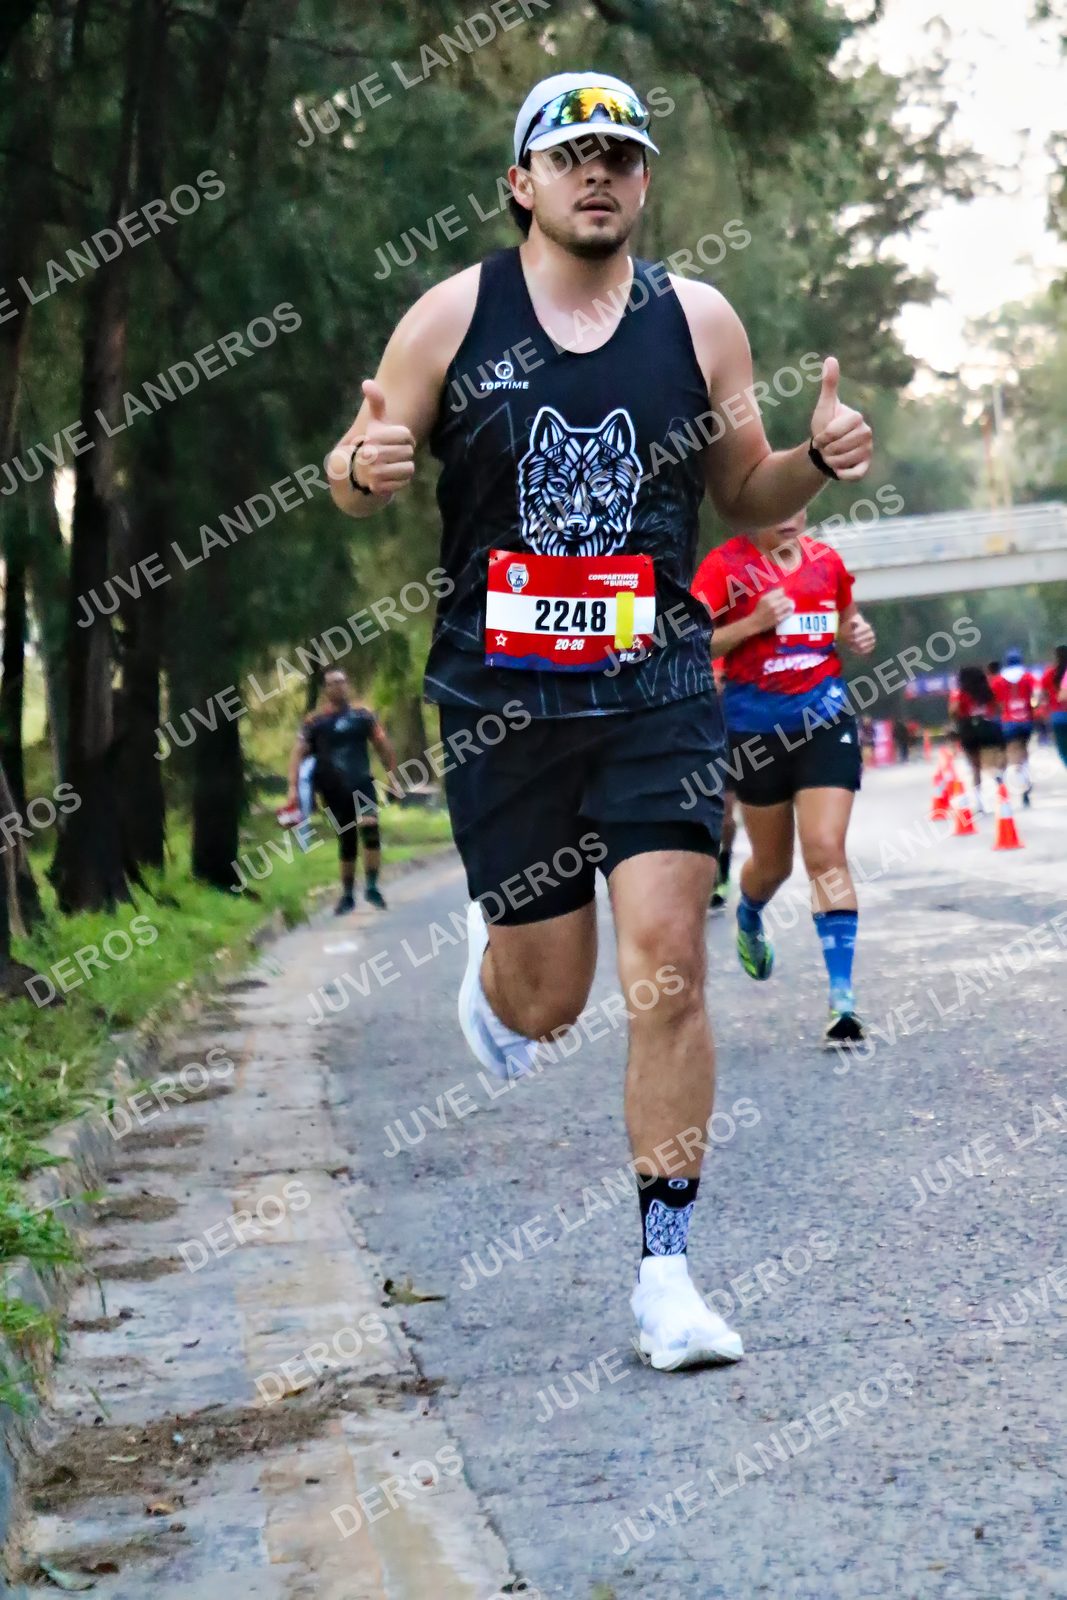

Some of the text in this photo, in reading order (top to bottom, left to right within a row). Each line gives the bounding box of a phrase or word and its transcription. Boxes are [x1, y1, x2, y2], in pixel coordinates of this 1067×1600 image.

[480, 381, 529, 390] TOPTIME
[535, 599, 607, 632] 2248
[799, 615, 827, 632] 1409
